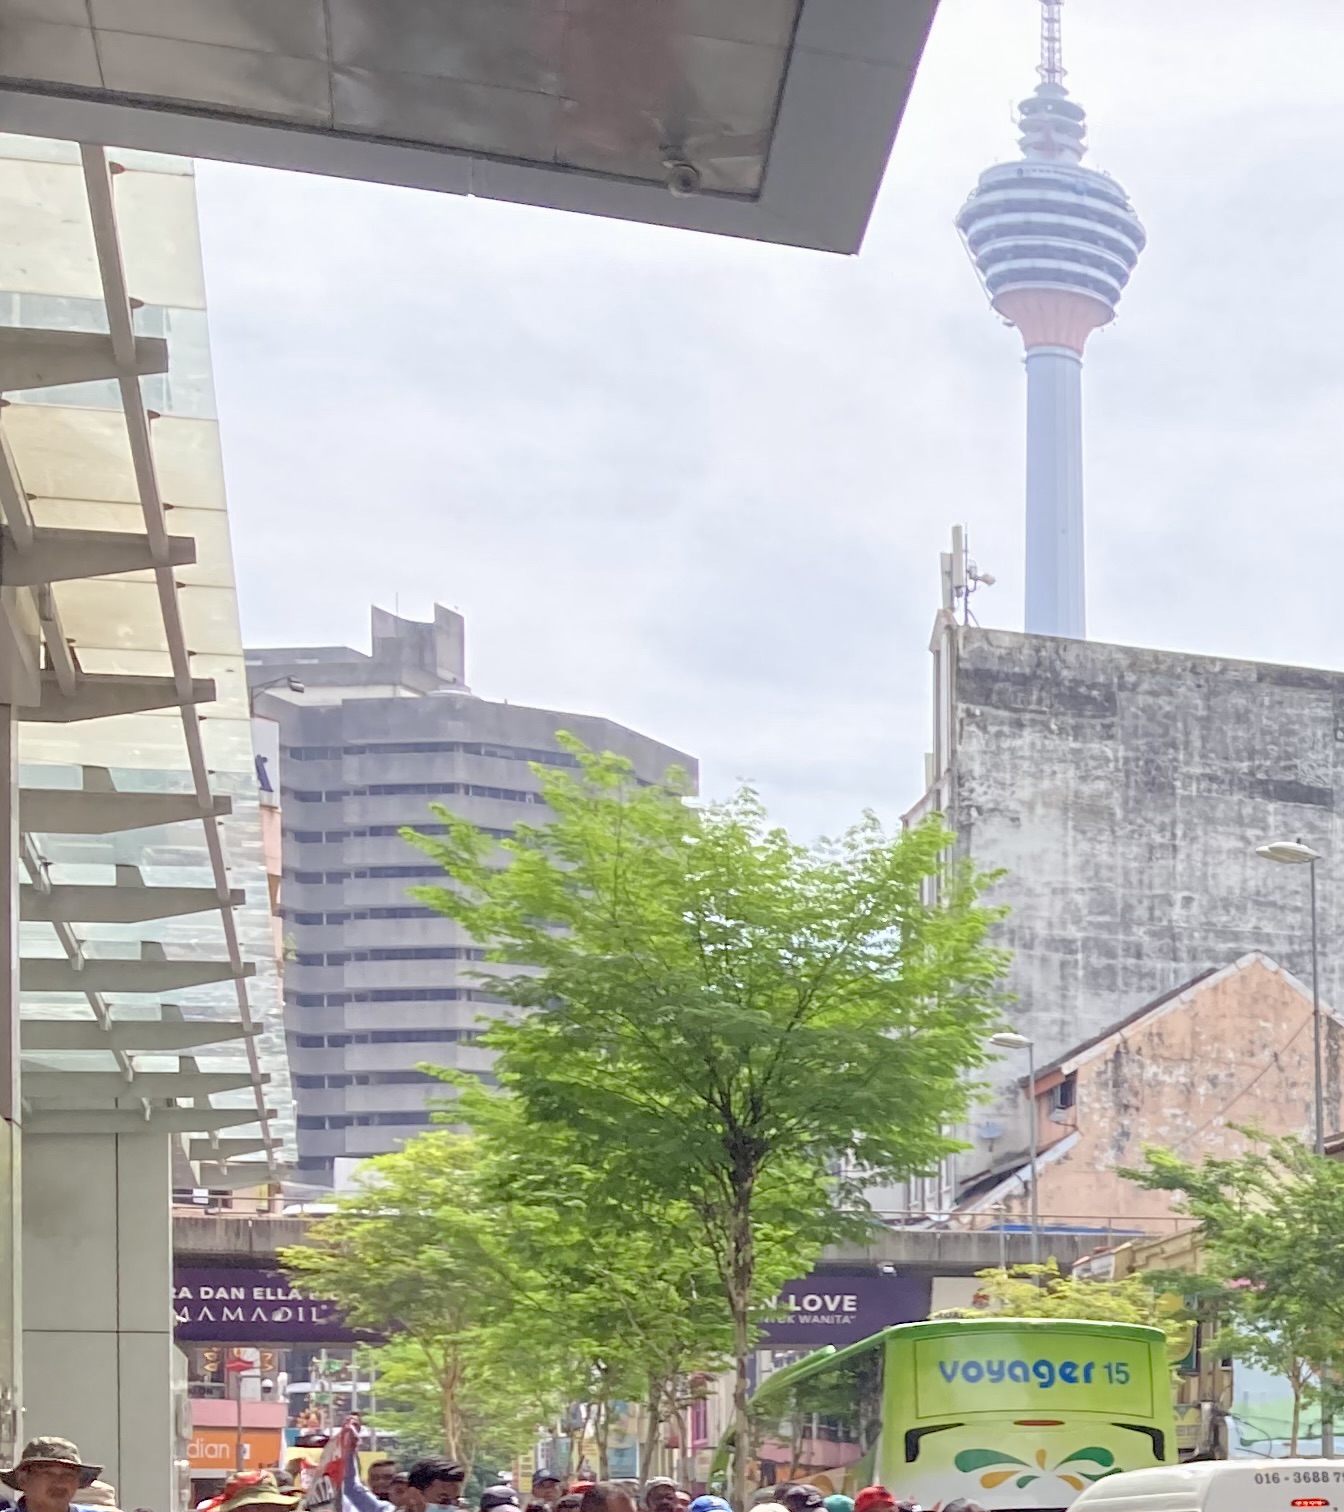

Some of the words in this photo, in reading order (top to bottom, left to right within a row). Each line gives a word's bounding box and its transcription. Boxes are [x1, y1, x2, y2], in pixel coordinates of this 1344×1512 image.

[200, 1287, 245, 1300] DAN
[253, 1287, 302, 1300] ELLA
[789, 1294, 858, 1312] LOVE
[938, 1359, 1095, 1388] voyager
[1103, 1362, 1130, 1385] 15
[1254, 1473, 1280, 1484] 016
[1293, 1471, 1330, 1483] 3688
